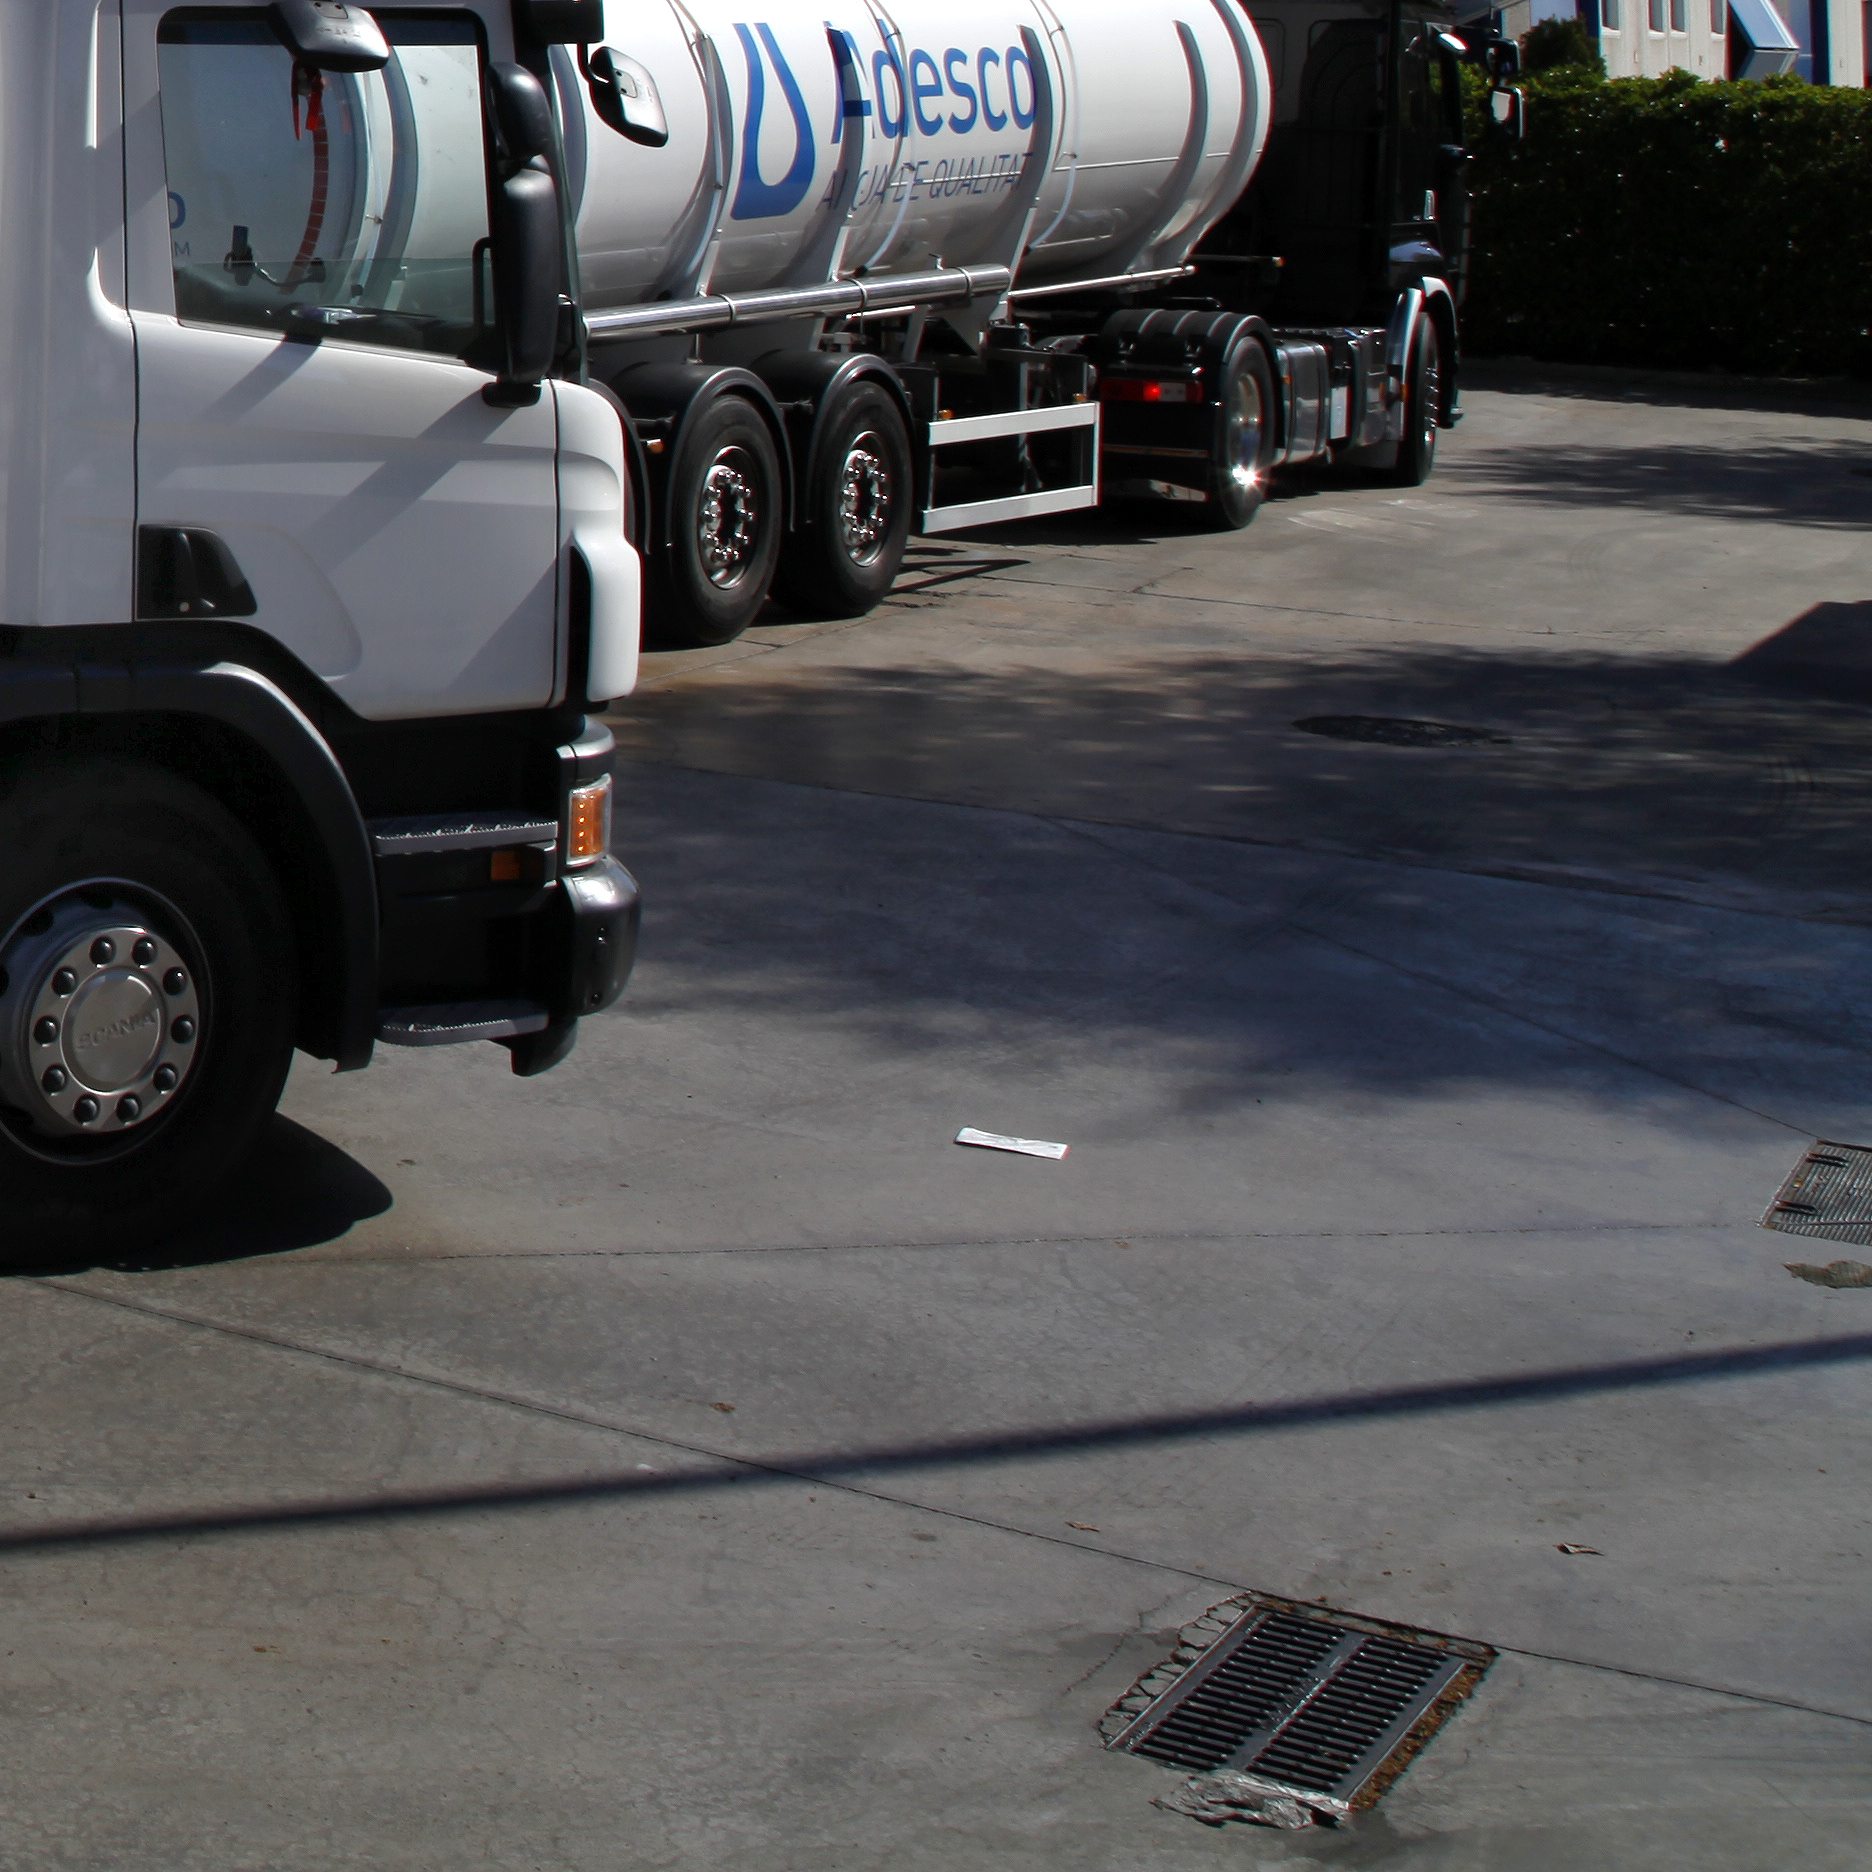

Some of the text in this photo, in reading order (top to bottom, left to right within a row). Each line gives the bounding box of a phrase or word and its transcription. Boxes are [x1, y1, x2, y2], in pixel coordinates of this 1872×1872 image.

[822, 17, 1036, 145] Adesco
[929, 152, 1035, 199] QUALITAT
[75, 1009, 157, 1052] SCANIA
